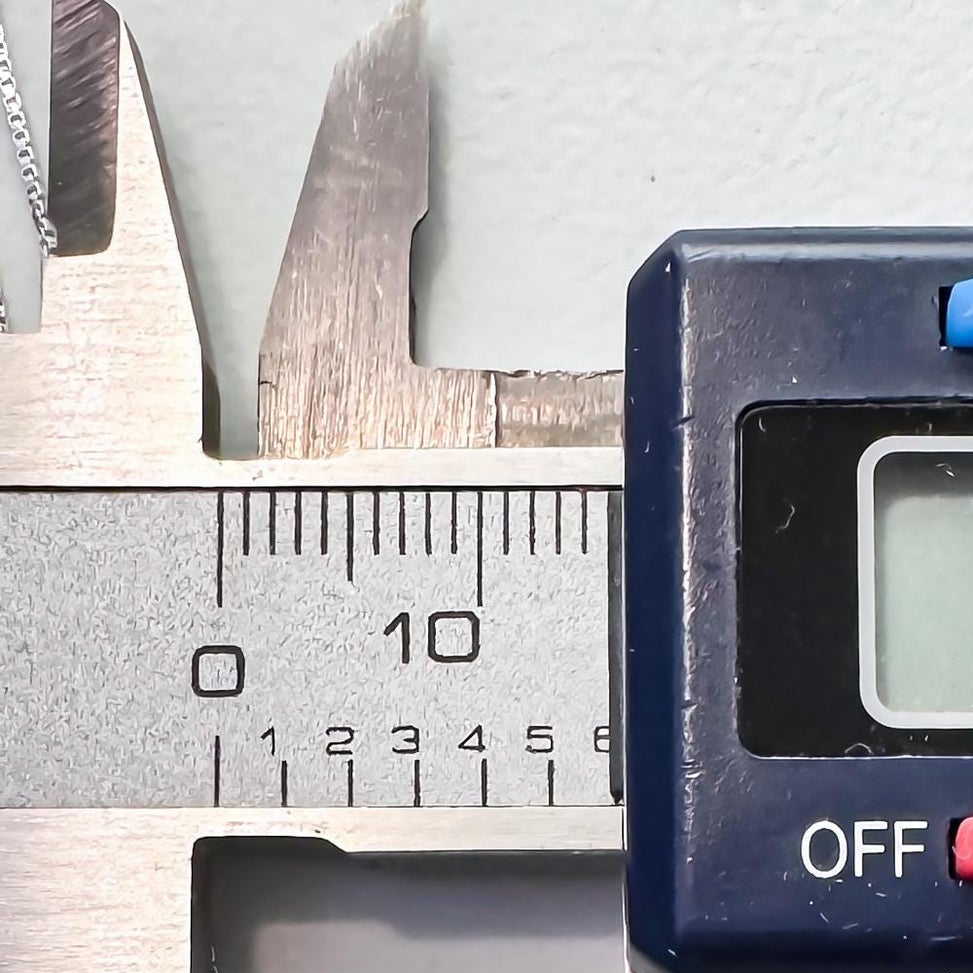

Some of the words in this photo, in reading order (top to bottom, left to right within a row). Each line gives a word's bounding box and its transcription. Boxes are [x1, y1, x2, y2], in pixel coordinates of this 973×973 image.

[384, 611, 480, 664] 10
[191, 645, 245, 697] 0
[260, 726, 276, 756] 1
[325, 726, 355, 756] 2
[391, 725, 420, 755] 3
[457, 724, 486, 753] 4
[525, 725, 554, 754] 5
[801, 819, 928, 879] OFF
